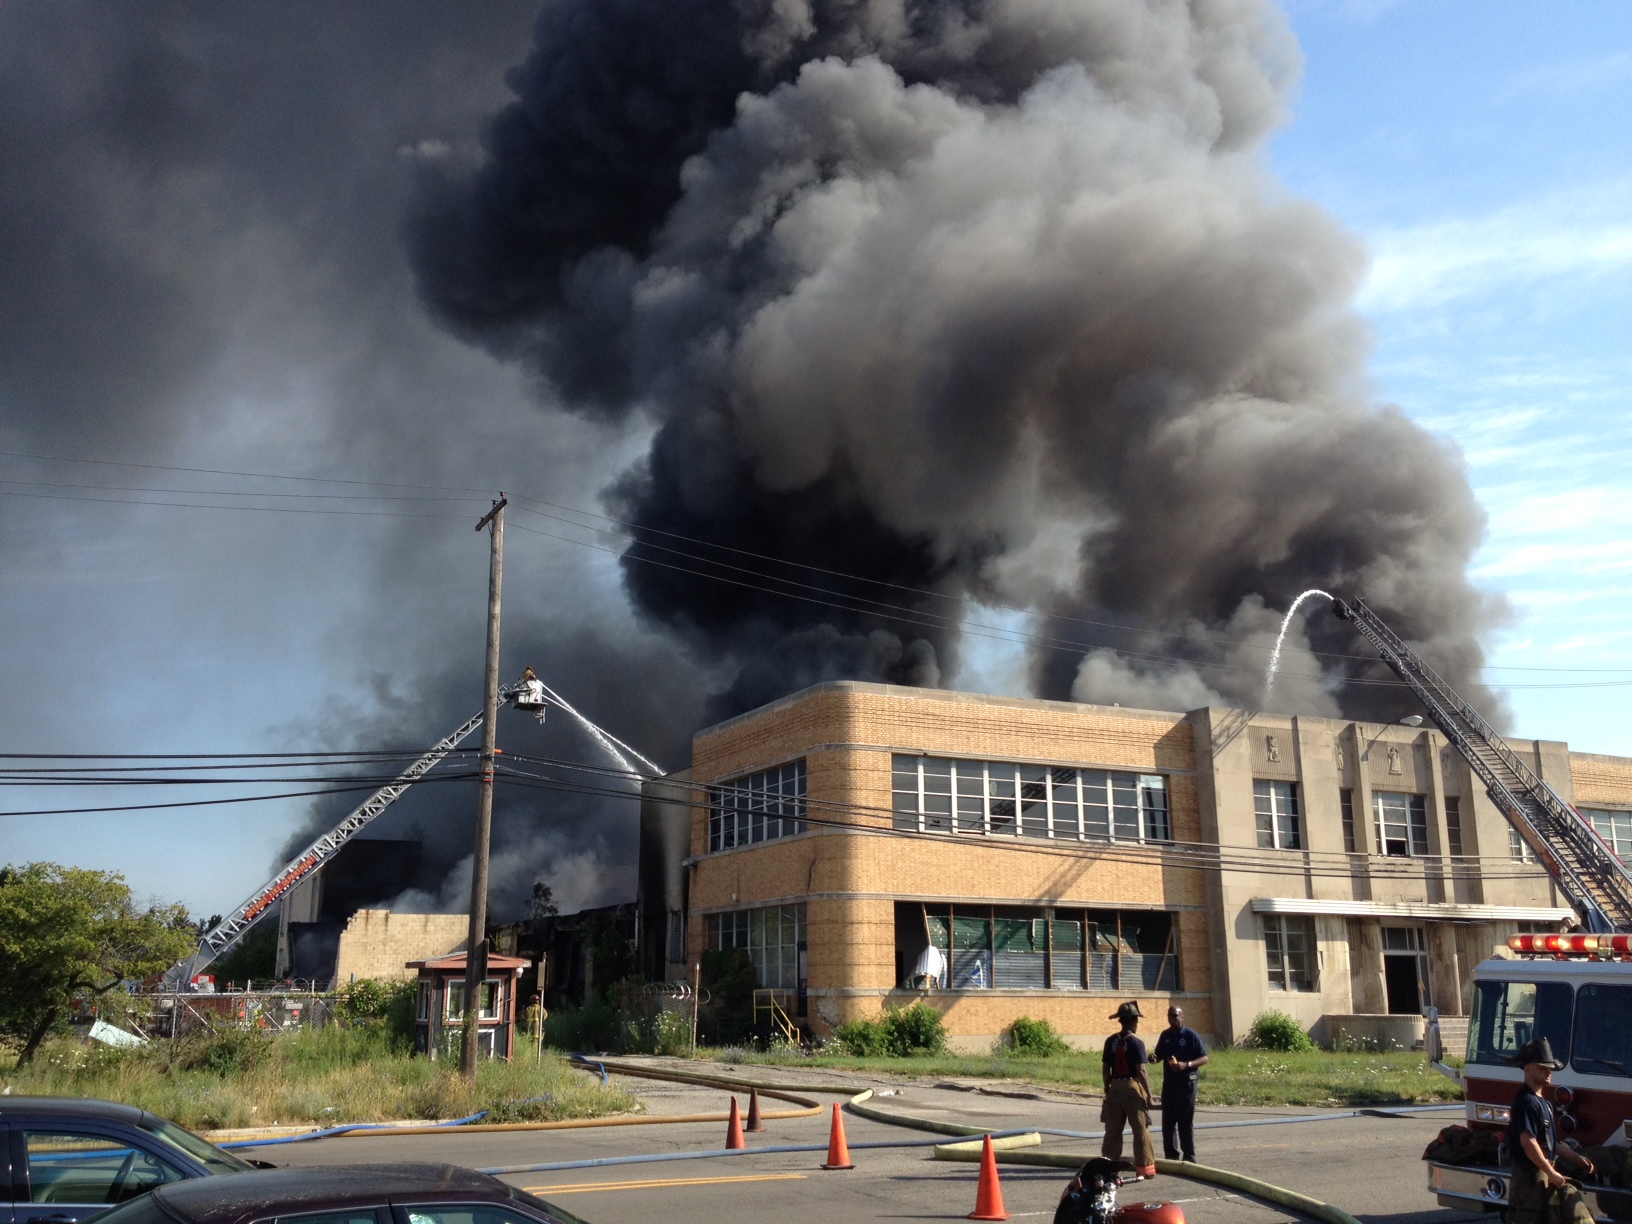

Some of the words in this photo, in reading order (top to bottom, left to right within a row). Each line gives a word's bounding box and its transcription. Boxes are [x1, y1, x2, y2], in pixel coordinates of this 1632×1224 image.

[246, 898, 267, 917] DETROIT
[269, 886, 281, 898] FIRE
[281, 857, 315, 886] DEPARTMENT
